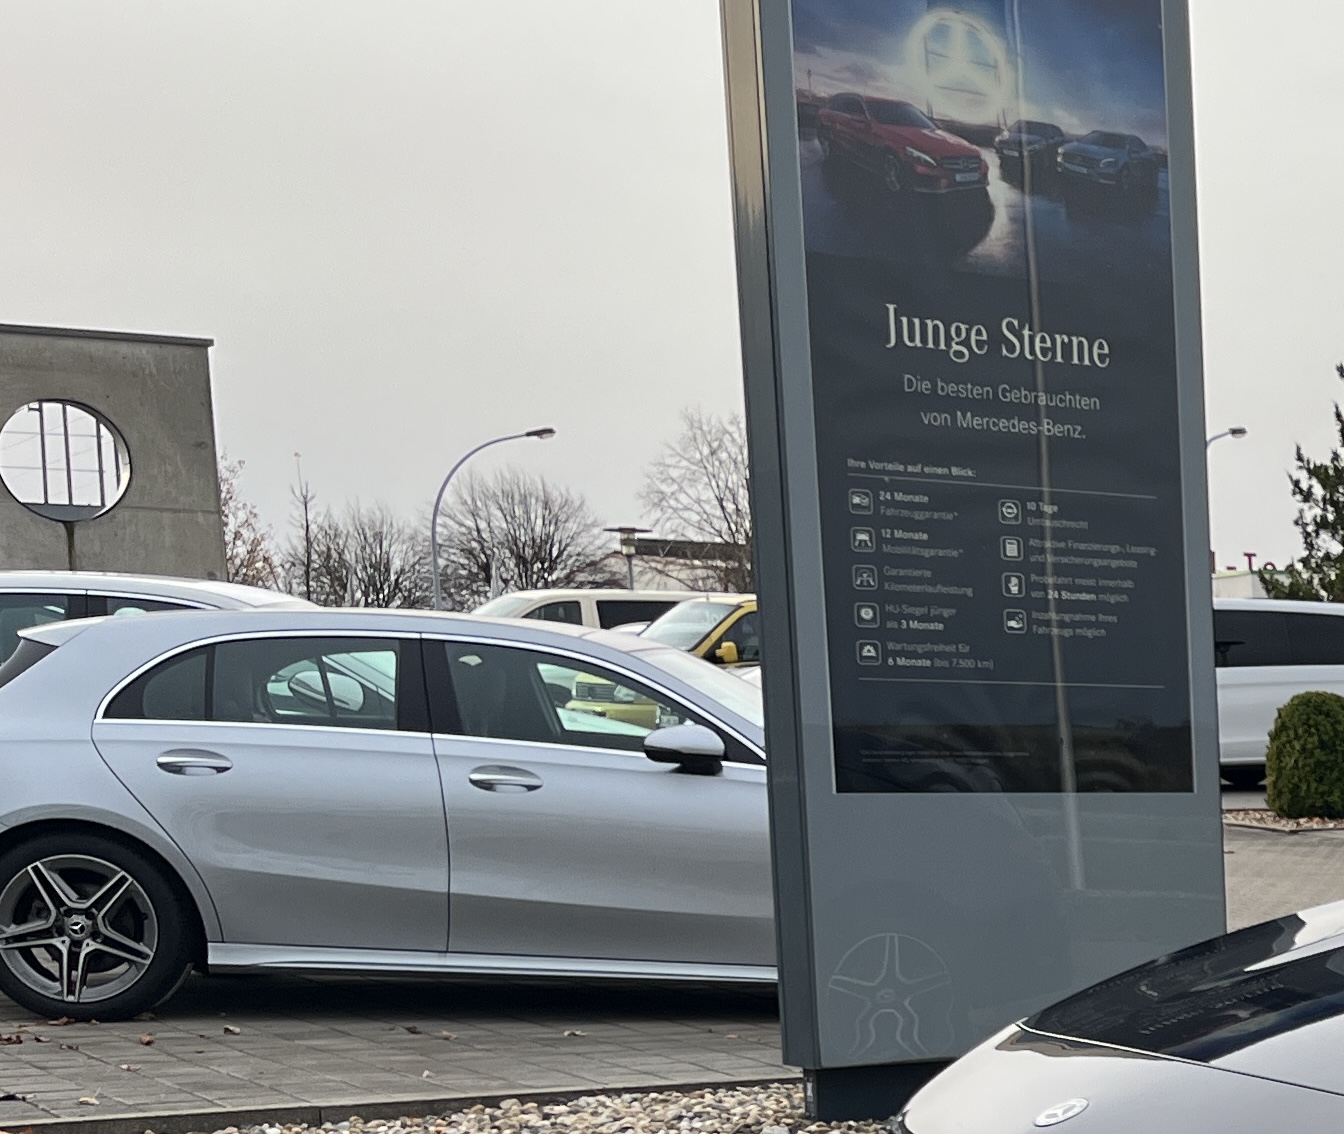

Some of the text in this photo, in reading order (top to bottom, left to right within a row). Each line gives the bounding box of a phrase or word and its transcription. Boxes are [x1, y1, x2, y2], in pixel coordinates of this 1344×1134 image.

[885, 303, 1110, 368] Junge Sterne
[903, 374, 1100, 410] Die besten Gebrauchten
[920, 411, 1086, 439] von Mercedes-Benz.
[868, 459, 905, 472] Vorteile
[907, 463, 922, 473] auf
[923, 465, 949, 475] einen
[879, 491, 929, 504] 24 Monate
[881, 529, 929, 541] 12 Monate
[900, 620, 907, 629] 3
[909, 620, 944, 631] Monate
[888, 657, 894, 666] 6
[896, 657, 931, 667] Monate
